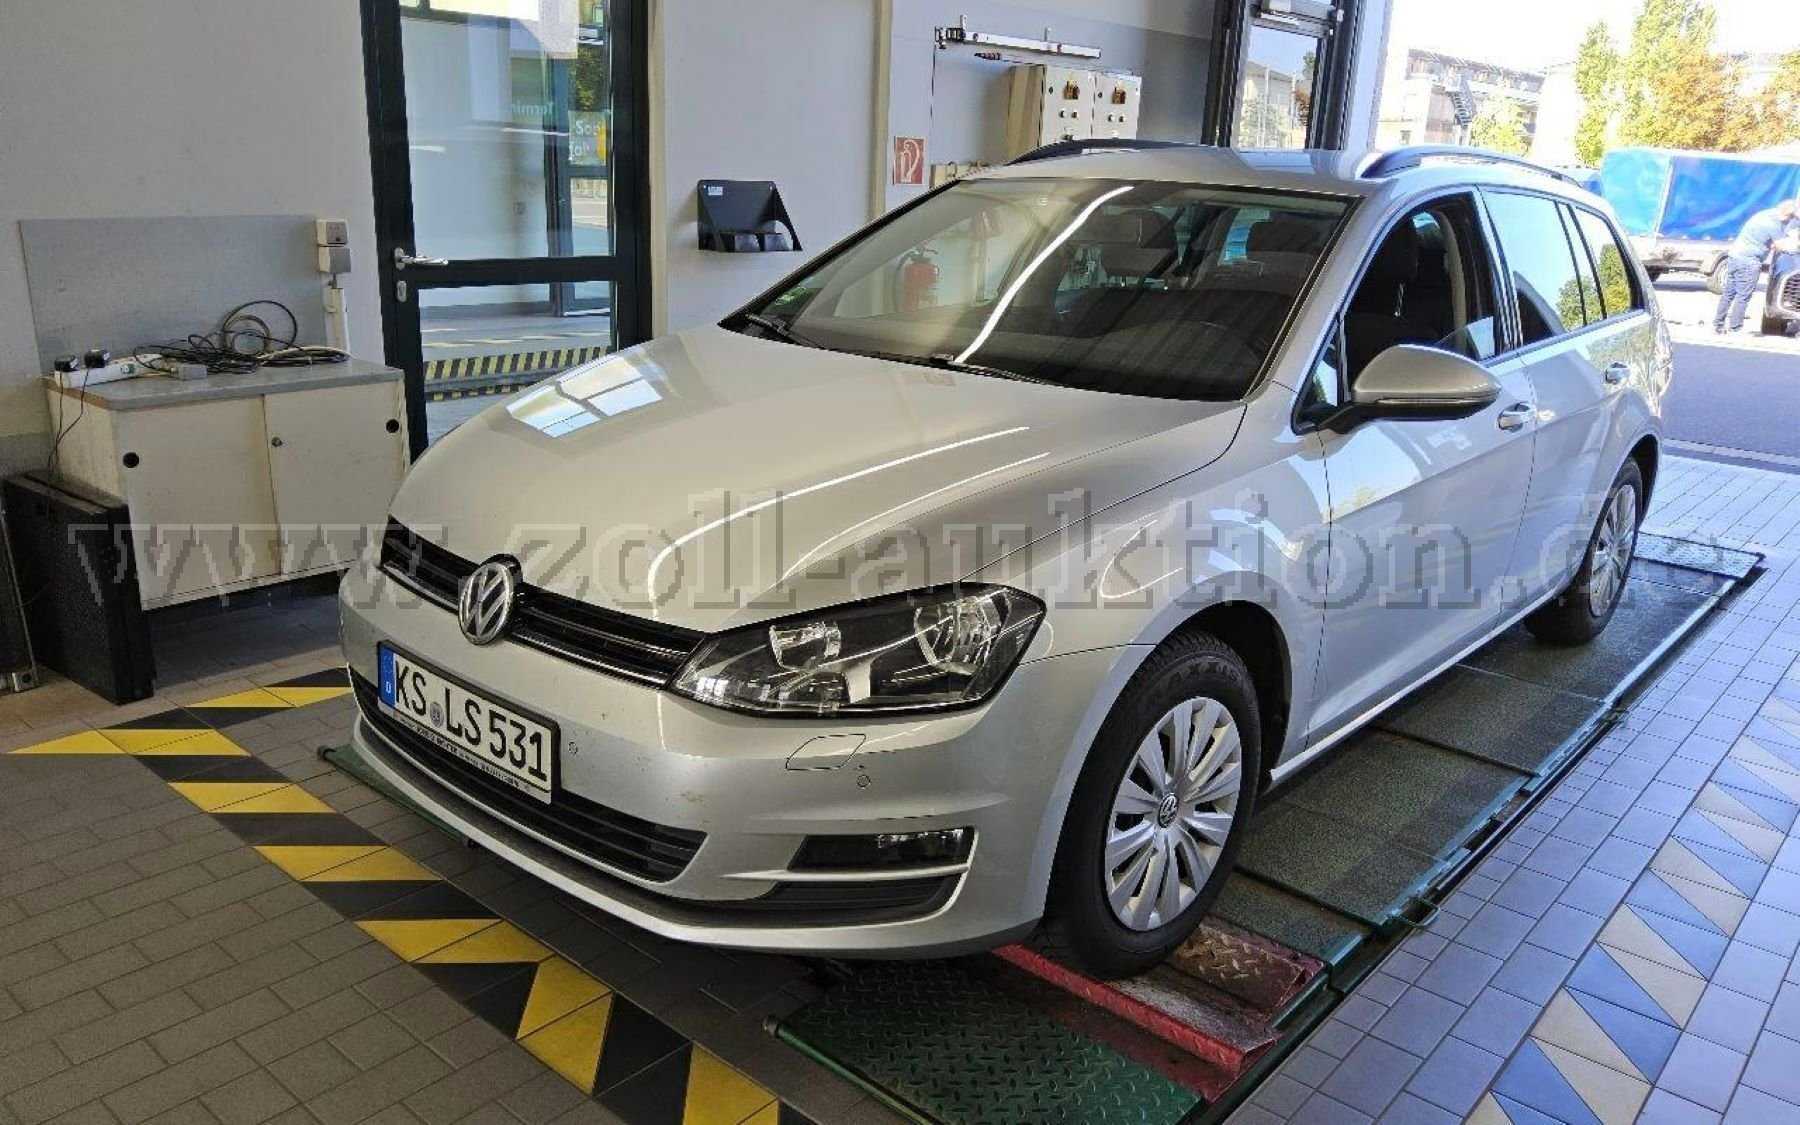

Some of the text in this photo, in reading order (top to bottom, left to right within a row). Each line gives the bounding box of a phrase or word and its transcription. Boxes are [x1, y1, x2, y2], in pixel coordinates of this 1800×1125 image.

[395, 660, 427, 716] KS
[444, 687, 481, 746] LS
[489, 709, 548, 782] 531
